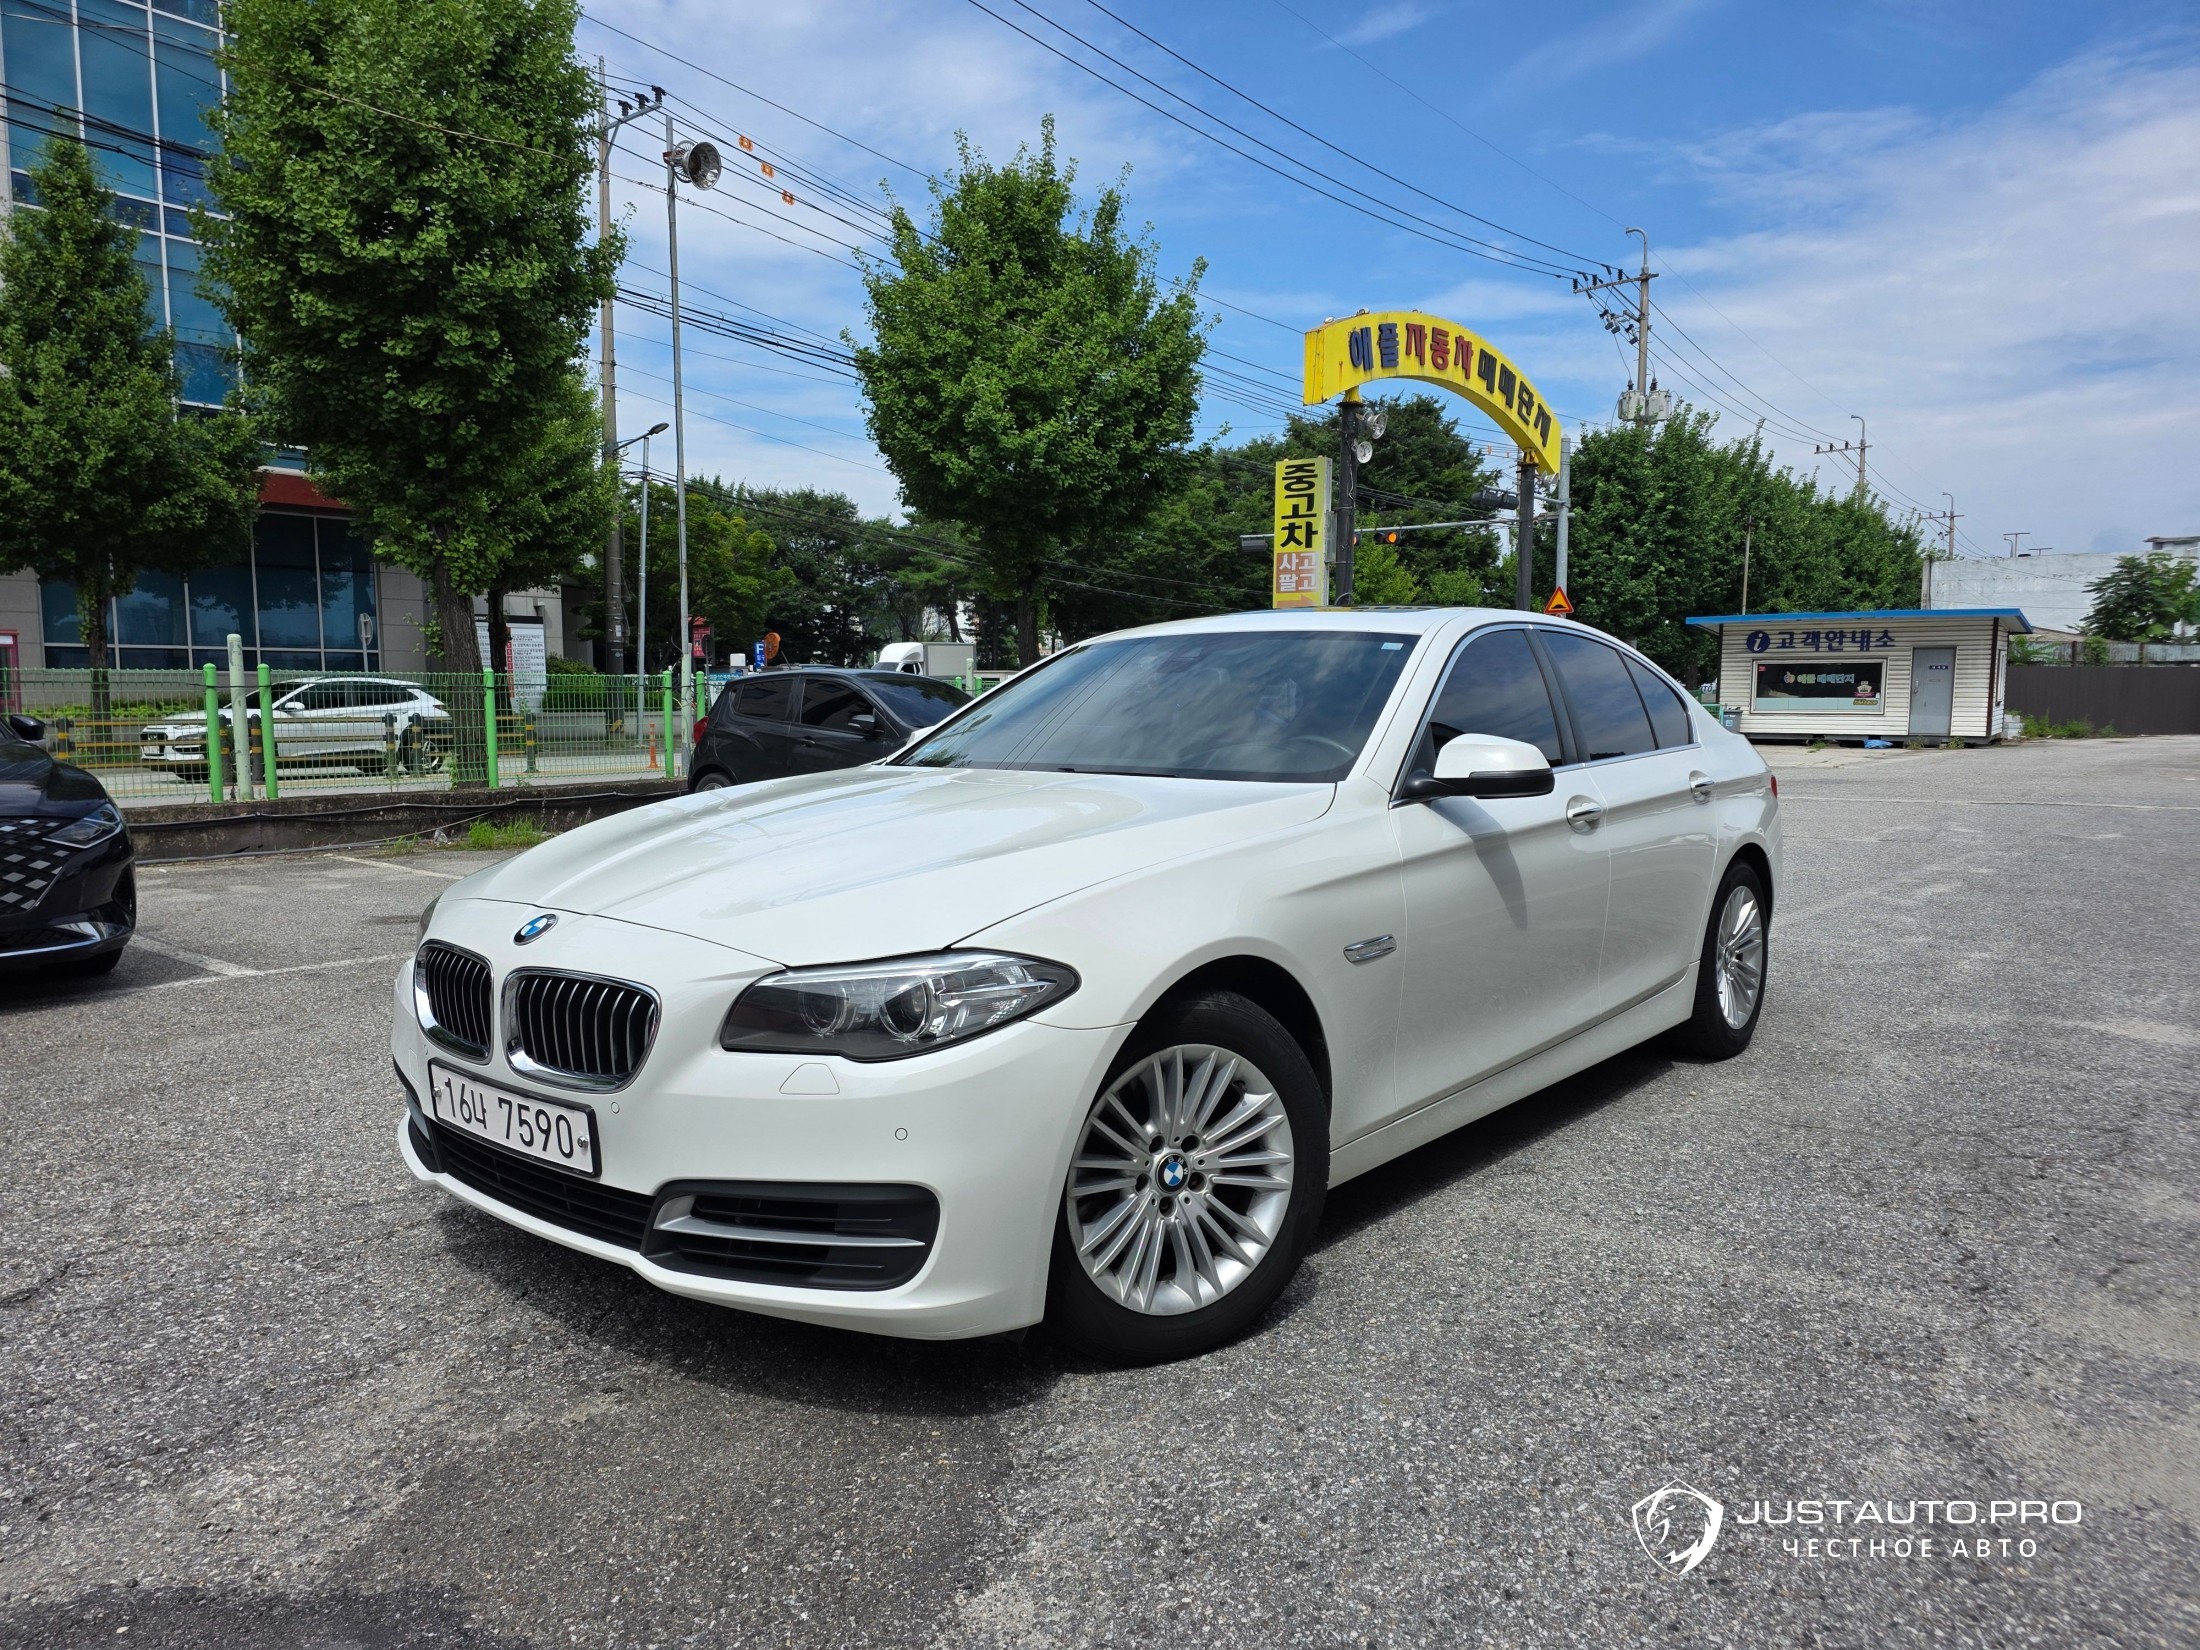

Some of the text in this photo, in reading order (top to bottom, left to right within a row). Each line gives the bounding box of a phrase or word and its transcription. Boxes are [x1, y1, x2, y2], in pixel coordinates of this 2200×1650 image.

[1350, 322, 1552, 447] 애플 자동차 매매단지
[1280, 462, 1318, 549] 중고차
[1776, 629, 1896, 652] 고객안내소
[445, 1077, 574, 1159] 16나 7590
[1168, 1157, 1188, 1174] BMW
